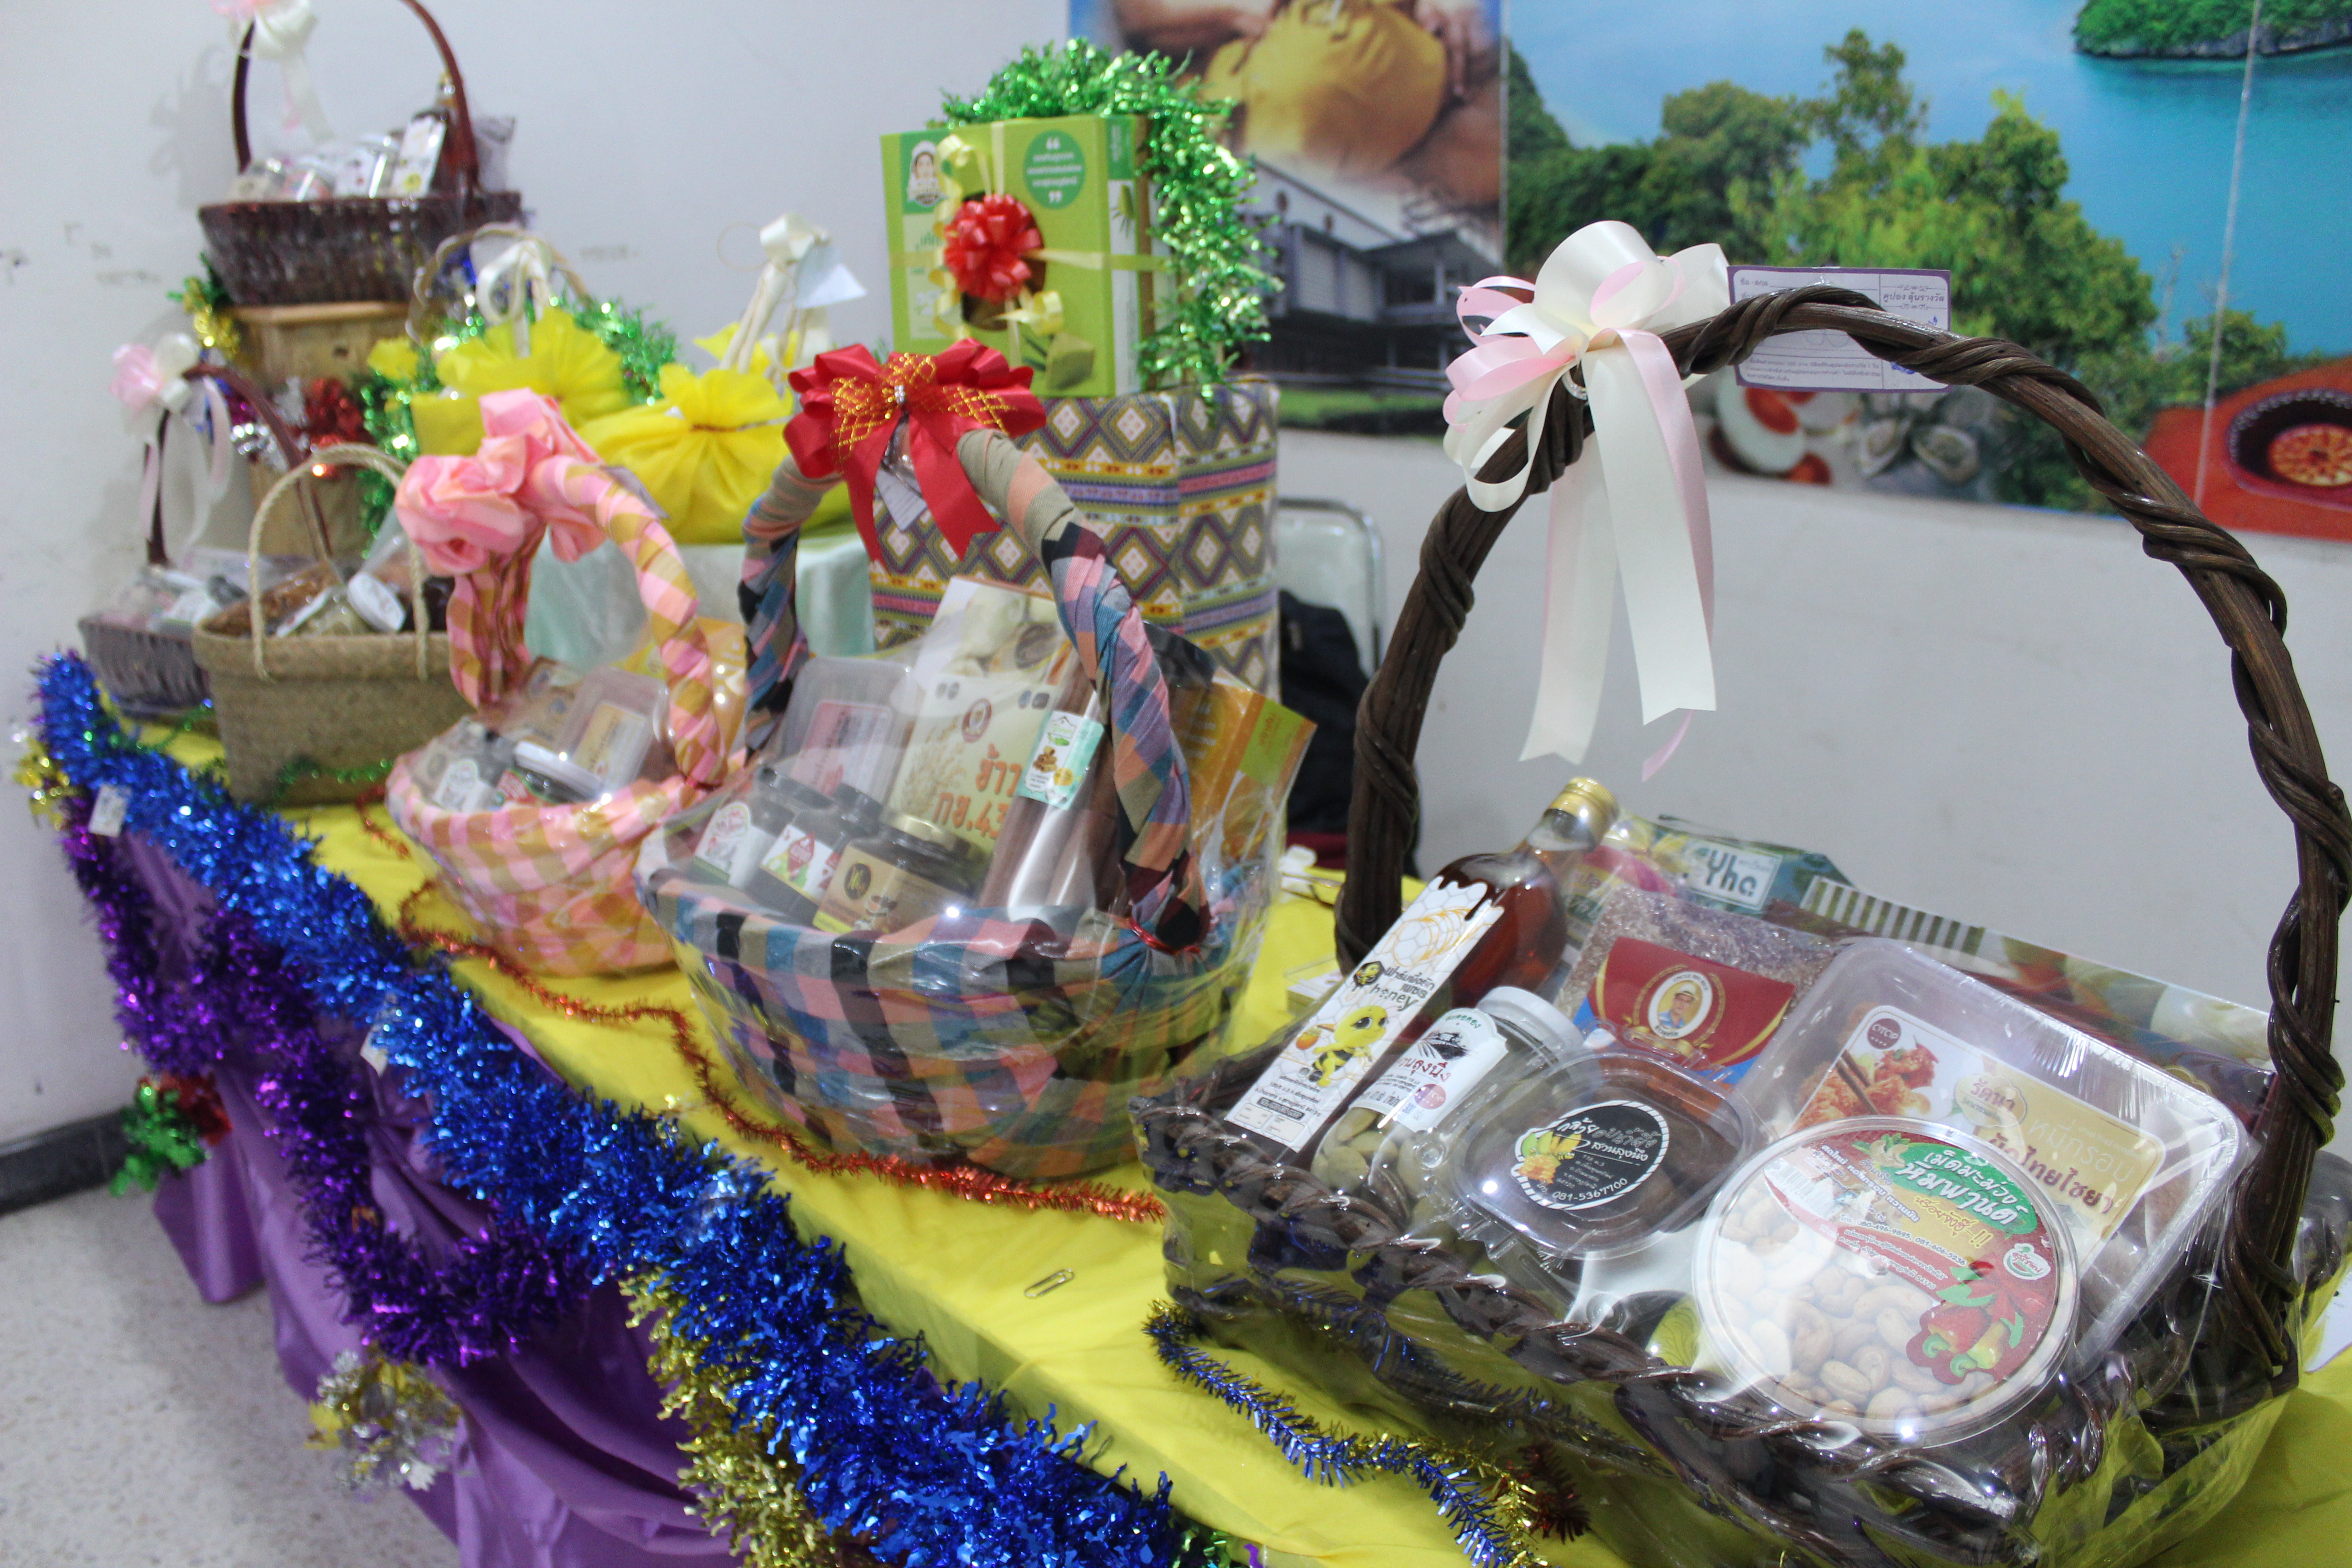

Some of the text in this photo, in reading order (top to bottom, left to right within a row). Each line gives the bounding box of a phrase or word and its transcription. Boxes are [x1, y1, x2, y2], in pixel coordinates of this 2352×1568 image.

[1883, 292, 1944, 303] คูปอง ลุ้นรางวัล
[976, 743, 1022, 797] ข้าว
[1369, 983, 1419, 1012] honey
[1872, 1024, 1899, 1039] OTOP
[2028, 1119, 2133, 1181] หมี่กรอบ
[1553, 1178, 1627, 1200] 081-5367700
[1924, 1150, 2018, 1204] เม็ดมะม่วง
[1895, 1161, 2029, 1225] หิมพานต์
[1886, 1195, 1920, 1223] หวานมัน
[1915, 1237, 1967, 1266] 081-606-5236
